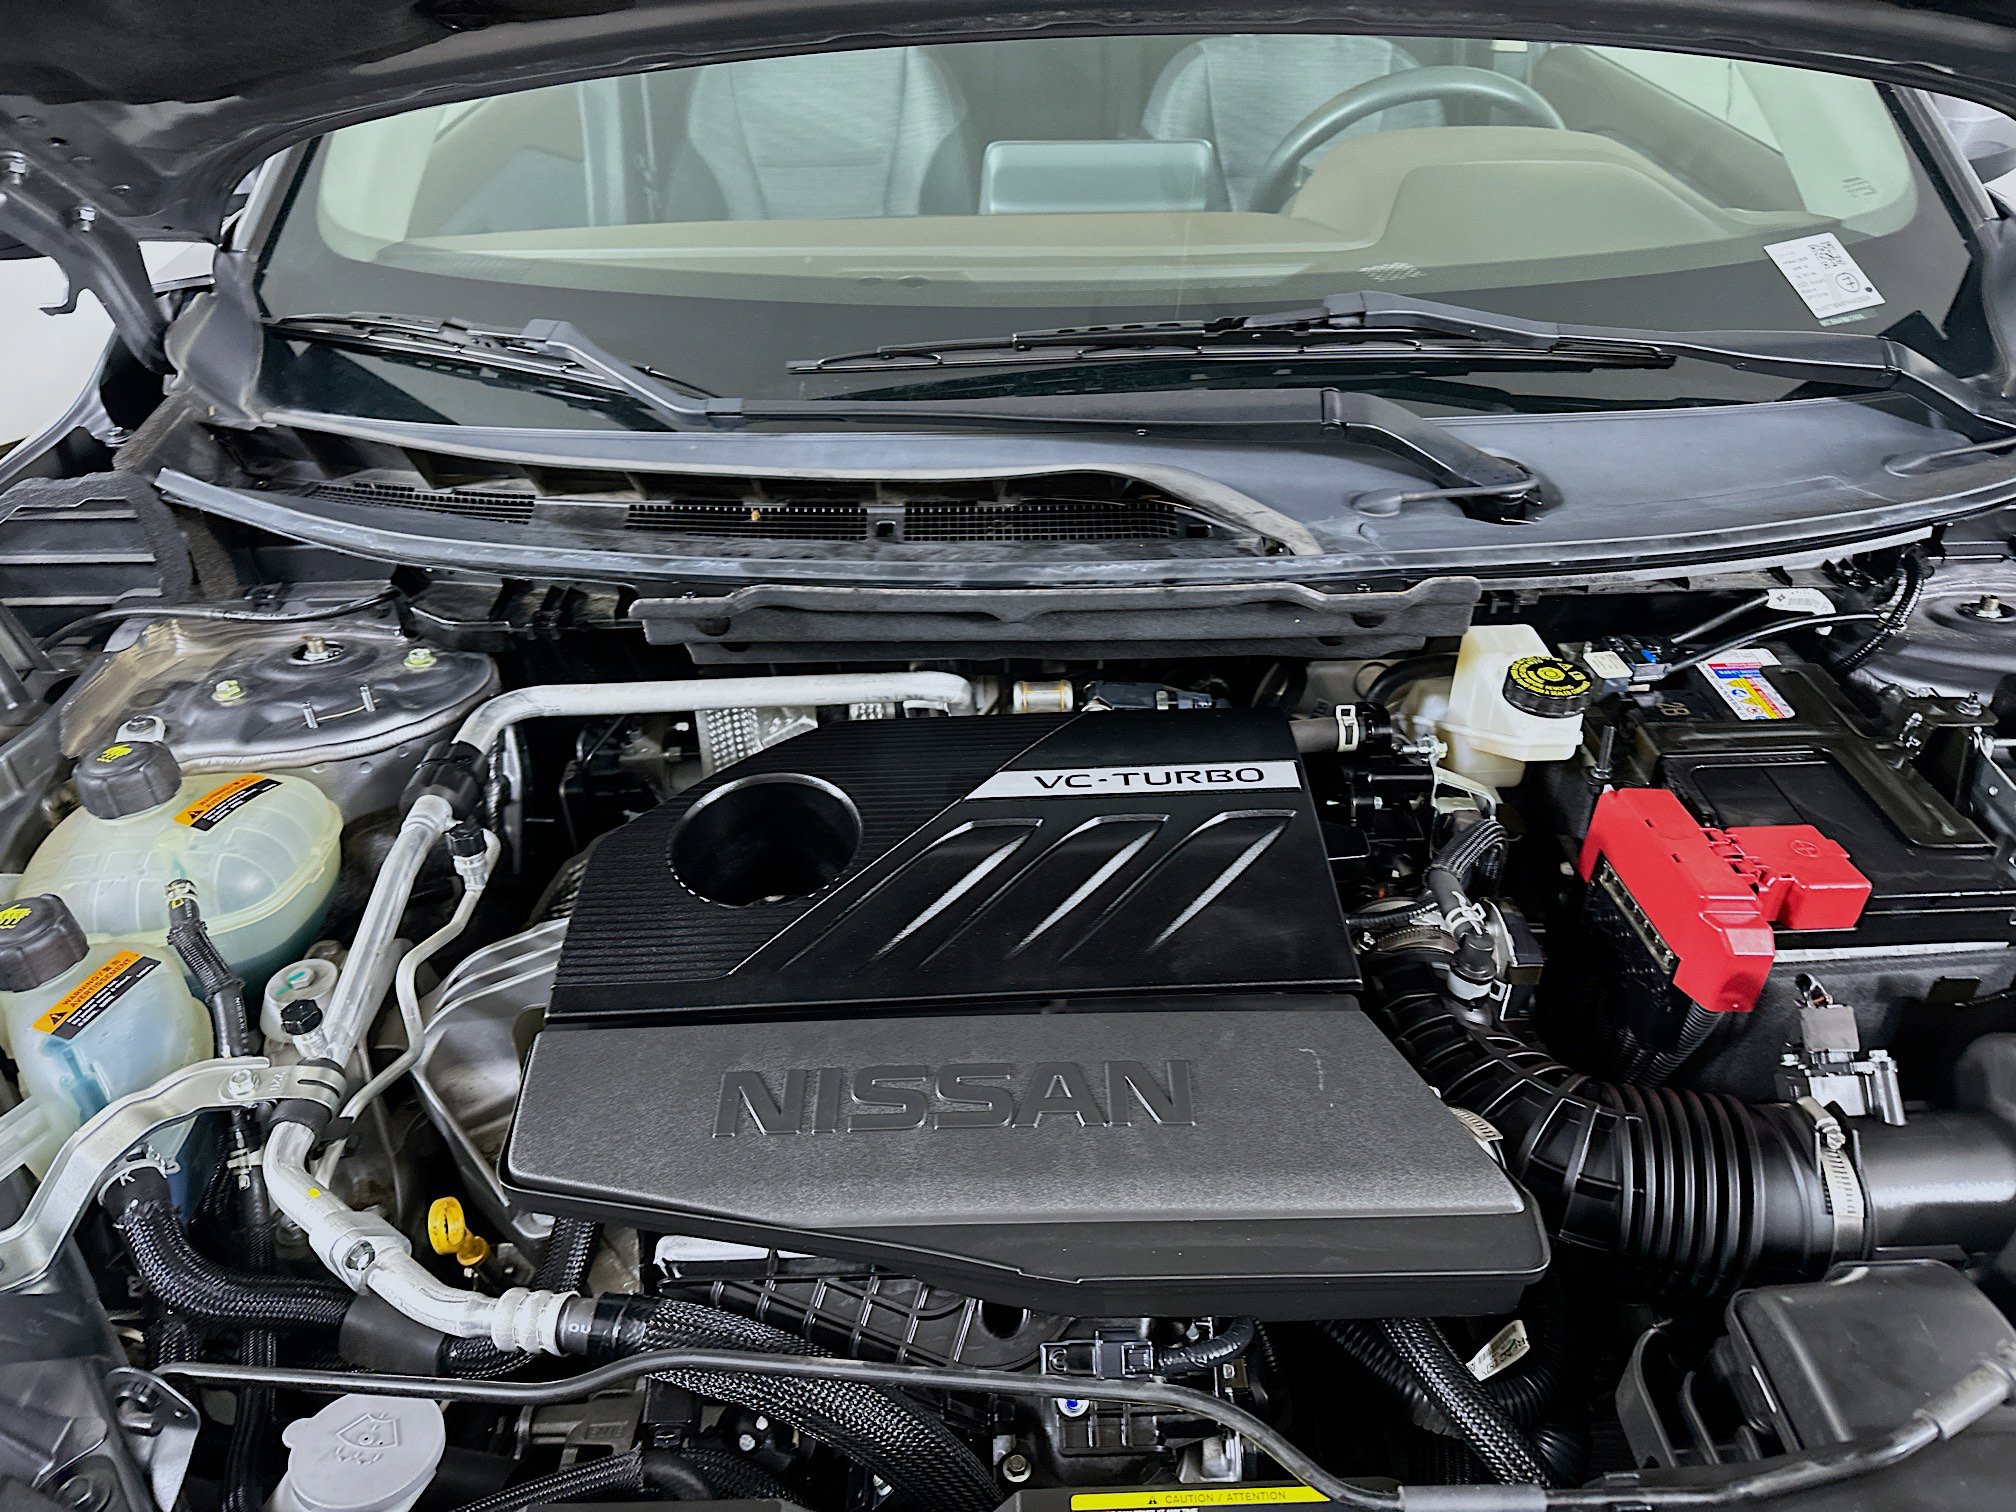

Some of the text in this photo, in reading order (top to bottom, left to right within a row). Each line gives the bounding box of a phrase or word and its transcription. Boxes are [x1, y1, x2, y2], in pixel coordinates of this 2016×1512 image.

[1034, 767, 1265, 789] VC-TURBO
[70, 958, 131, 1008] AVERTISSEMENT
[711, 1060, 1197, 1138] NISSAN
[1165, 1493, 1214, 1504] CAUTION
[1226, 1491, 1287, 1502] ATTENTION
